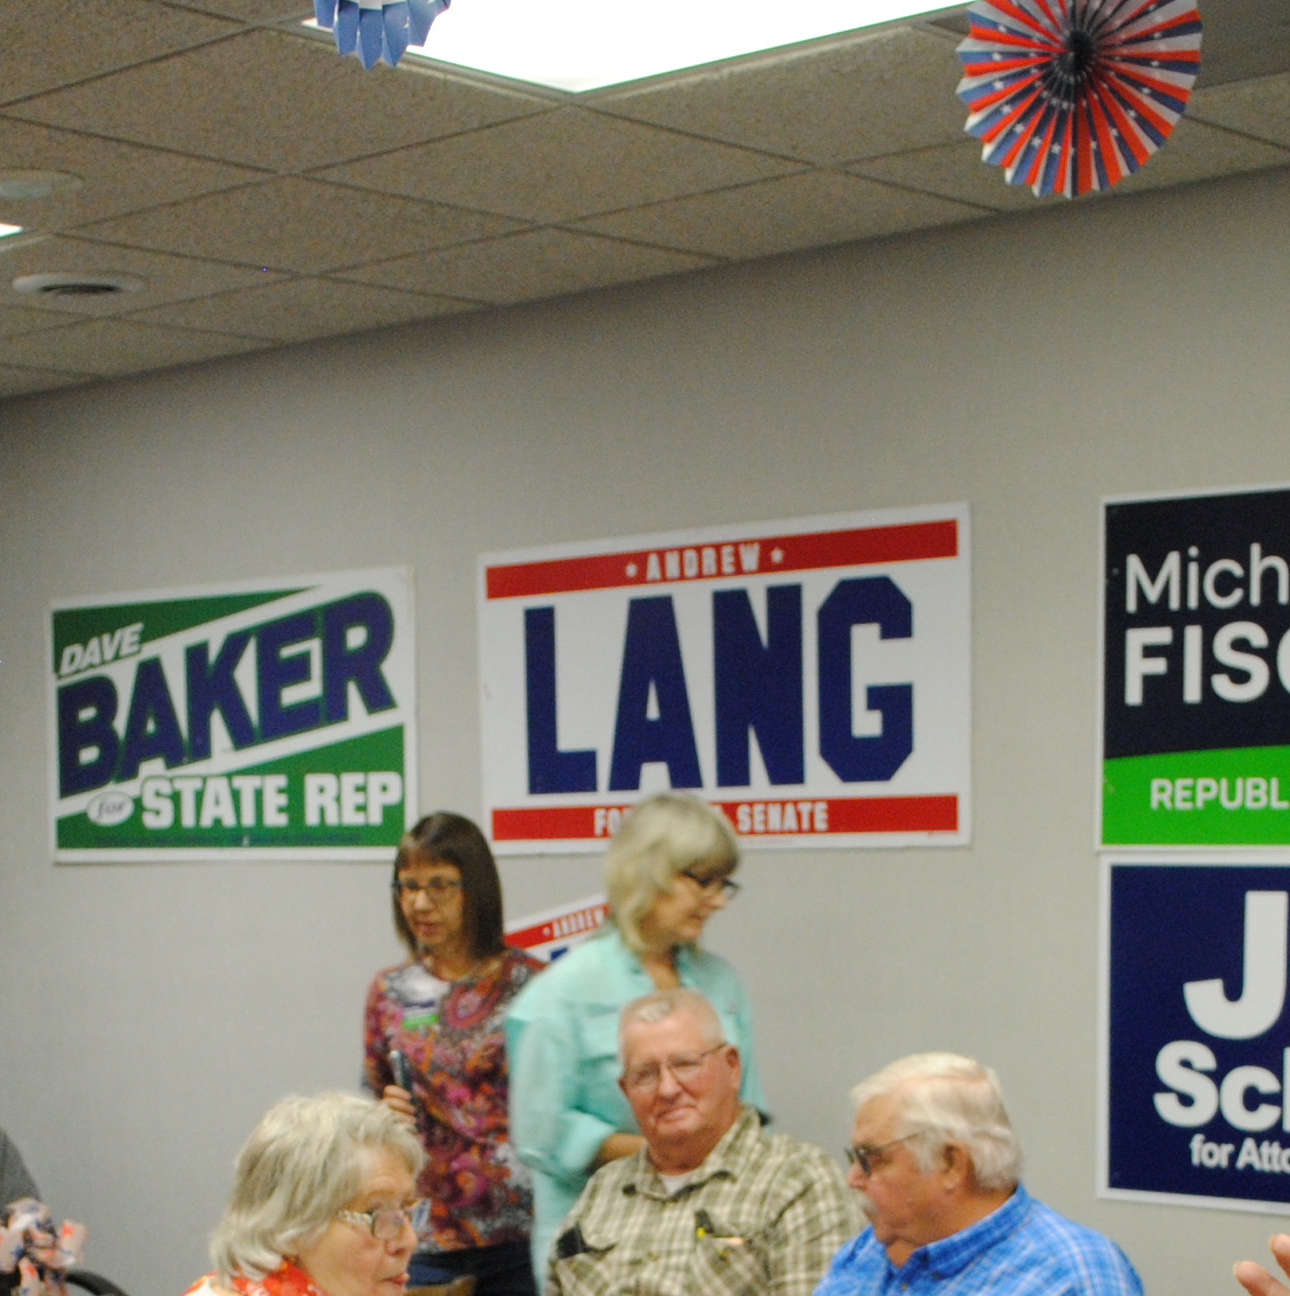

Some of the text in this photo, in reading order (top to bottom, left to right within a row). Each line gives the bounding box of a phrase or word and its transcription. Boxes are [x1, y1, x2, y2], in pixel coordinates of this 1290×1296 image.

[646, 543, 761, 582] ANDREW
[59, 622, 144, 677] DAVE
[57, 590, 399, 799] BAKER
[523, 575, 915, 794] LANG
[141, 775, 290, 829] STATE
[304, 772, 403, 827] REP
[594, 806, 634, 836] FO
[736, 801, 829, 833] SENATE
[1190, 1134, 1234, 1168] for
